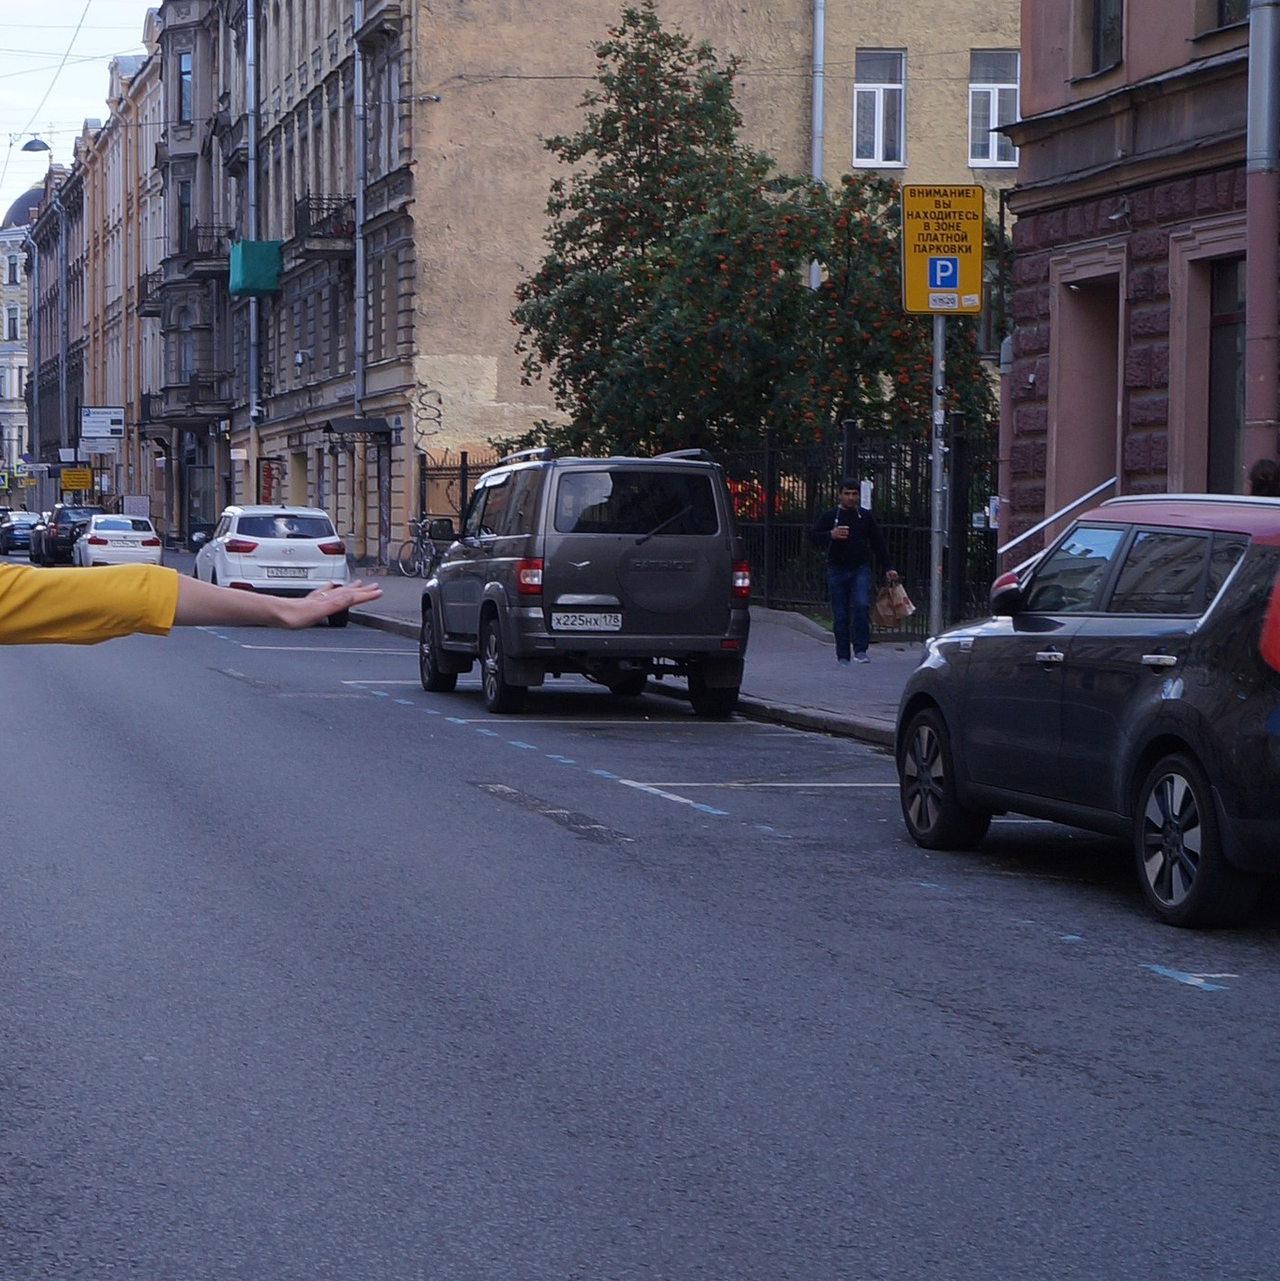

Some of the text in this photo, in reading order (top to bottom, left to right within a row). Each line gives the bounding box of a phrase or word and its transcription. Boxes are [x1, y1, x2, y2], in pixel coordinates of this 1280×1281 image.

[909, 188, 976, 198] ВНИМАНИЕ!
[934, 199, 952, 209] ВЫ
[906, 210, 979, 221] НАХОДИТЕСЬ
[923, 221, 962, 231] В ЗОНЕ
[917, 231, 968, 243] ПЛАТНОЙ
[913, 244, 972, 254] ПАРКОВКИ
